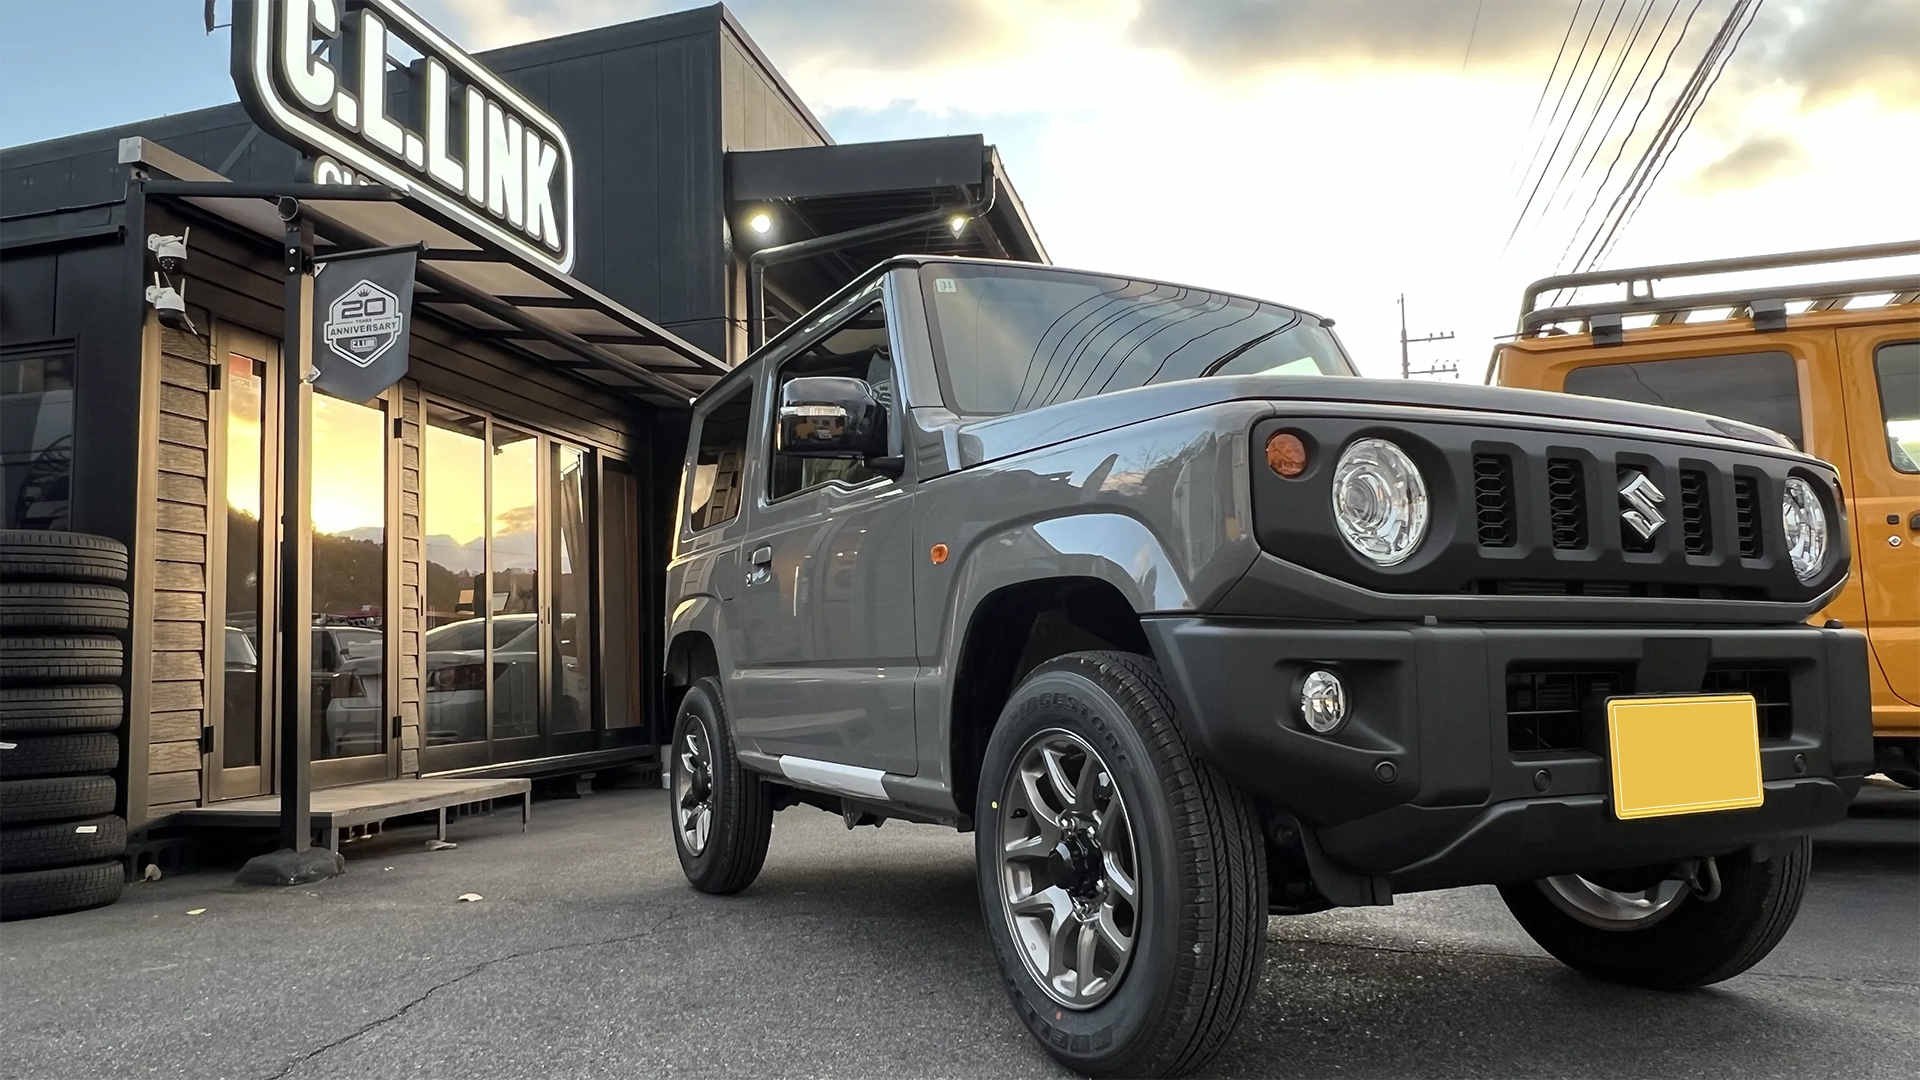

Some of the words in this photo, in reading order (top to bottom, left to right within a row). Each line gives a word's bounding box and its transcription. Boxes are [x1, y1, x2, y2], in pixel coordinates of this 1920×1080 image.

[283, 0, 561, 250] C.L.LINK
[341, 297, 386, 319] 20
[330, 321, 397, 336] ANNIVERSARY
